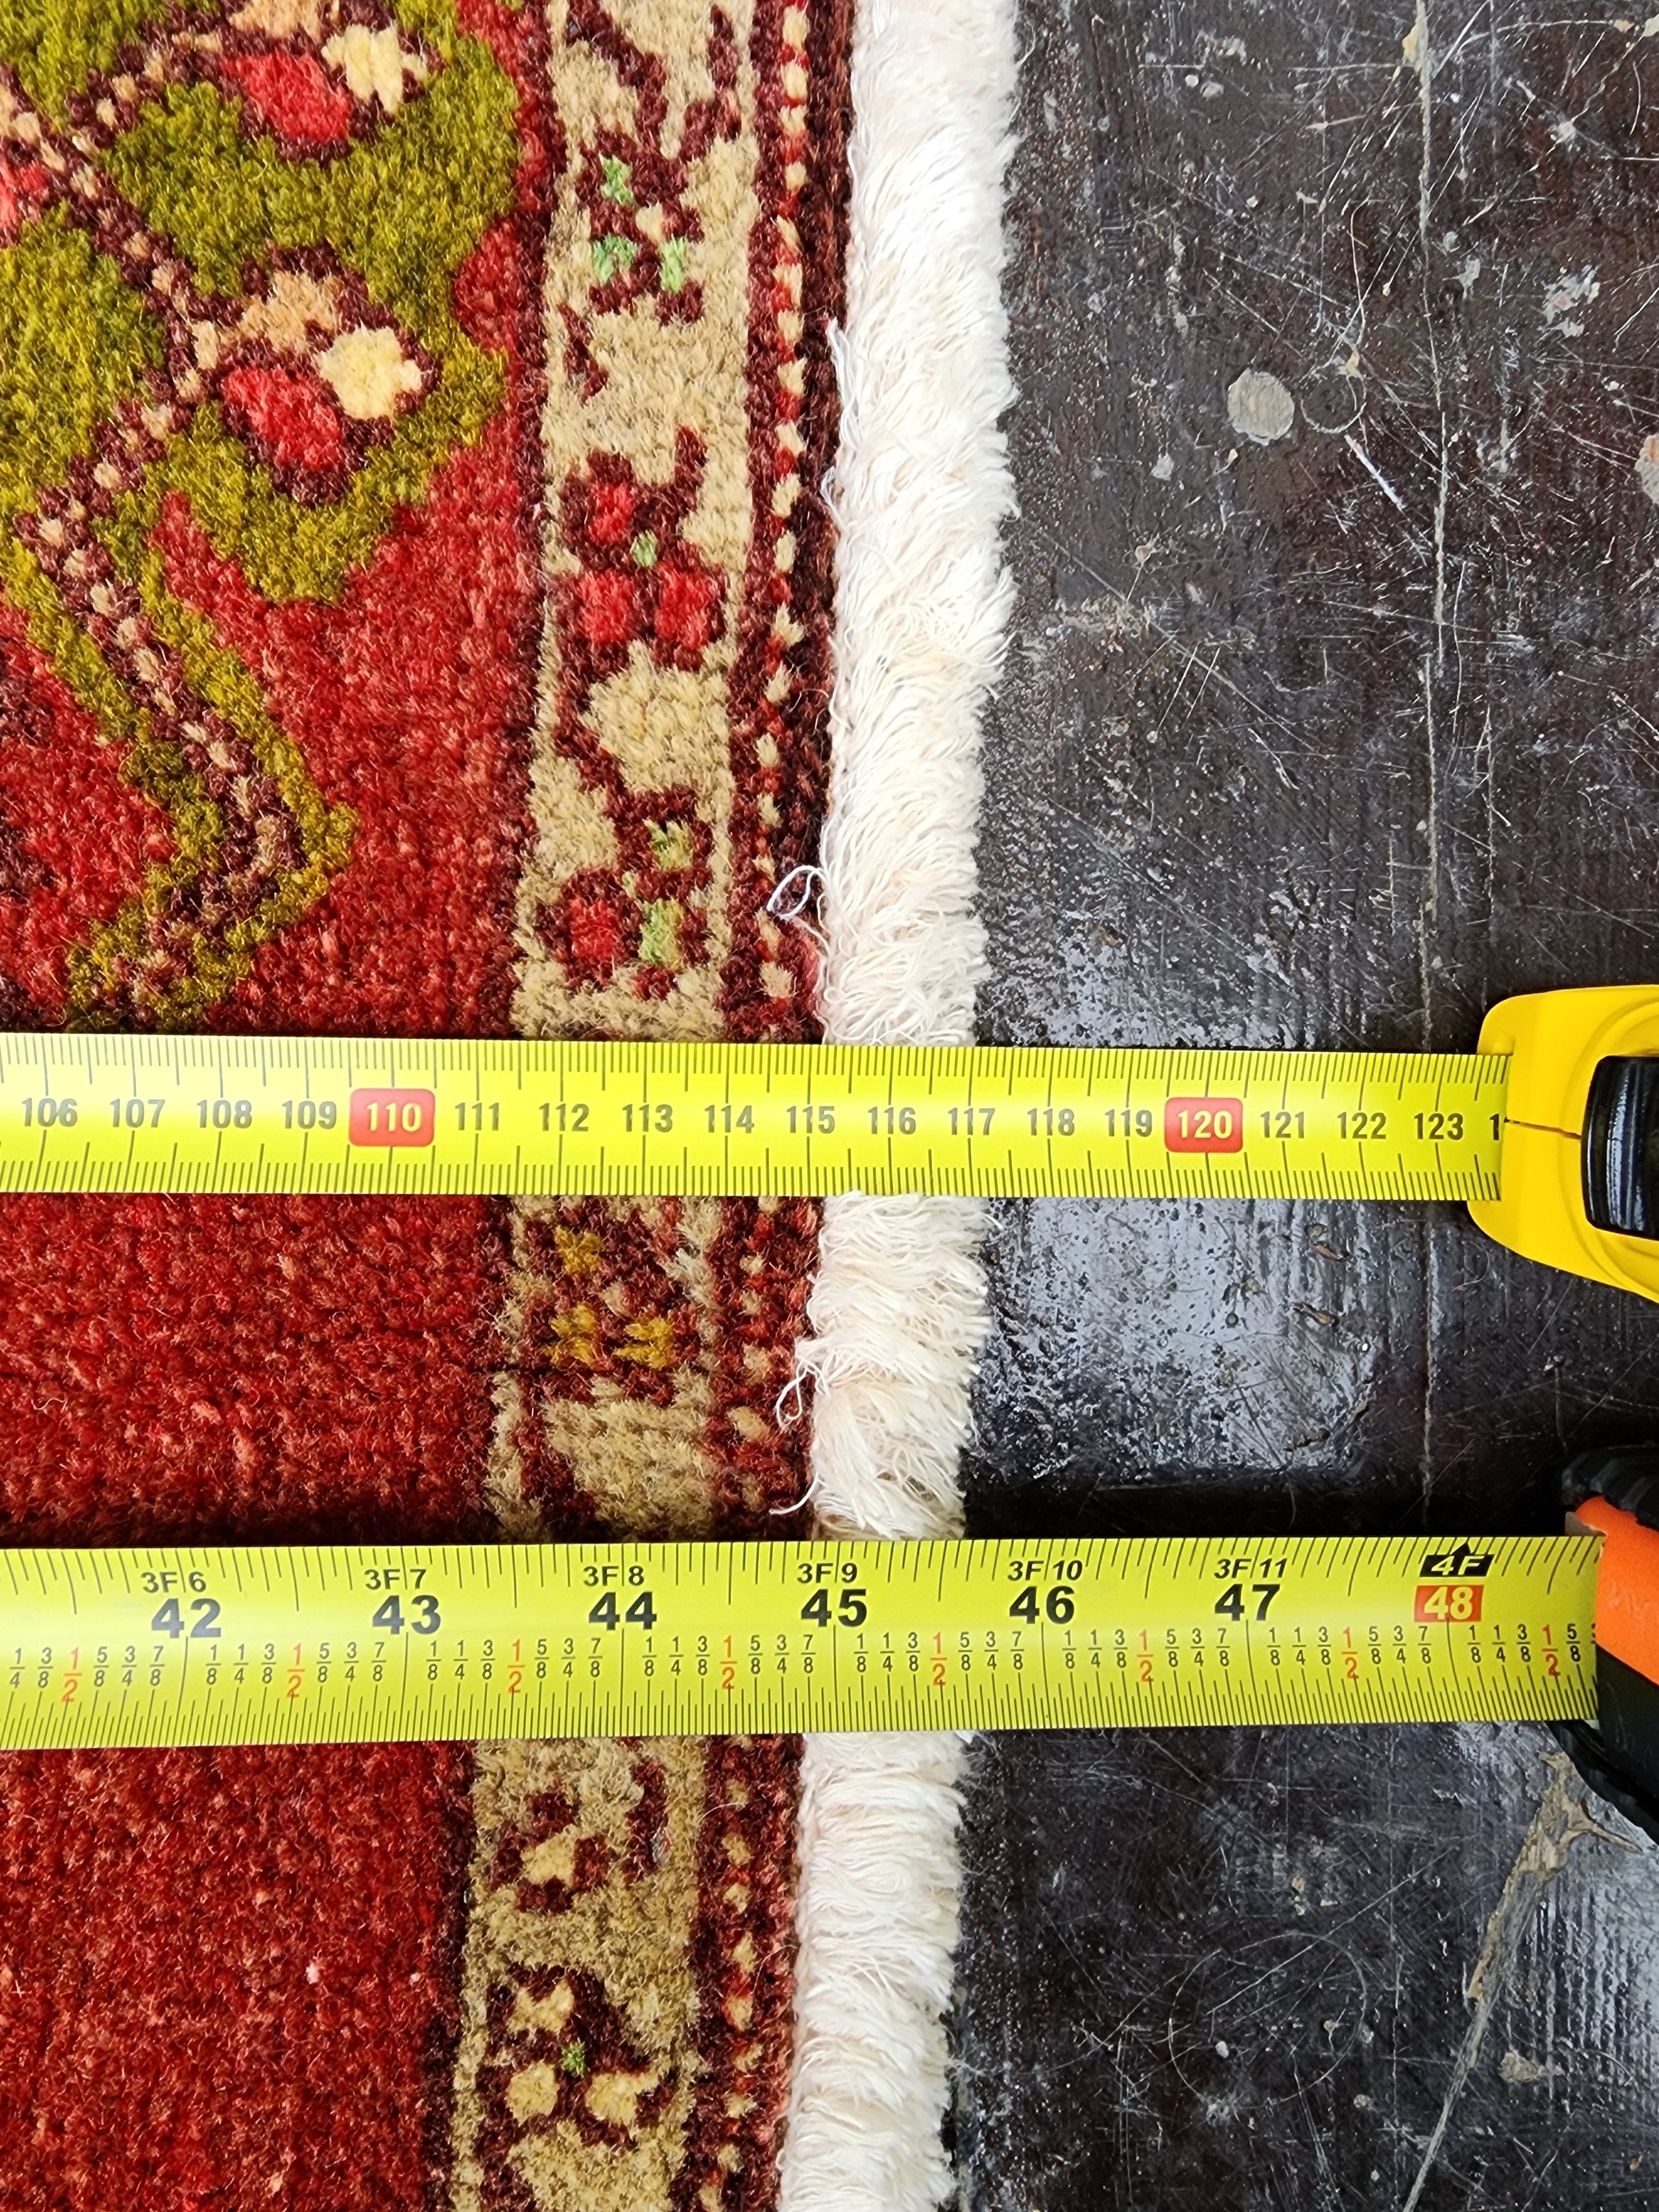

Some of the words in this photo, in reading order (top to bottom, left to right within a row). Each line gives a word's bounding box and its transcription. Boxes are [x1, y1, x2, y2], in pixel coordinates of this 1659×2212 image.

[22, 1098, 77, 1127] 106
[110, 1099, 165, 1128] 107
[197, 1099, 252, 1129] 108
[282, 1100, 337, 1129] 109
[366, 1103, 421, 1131] 110
[455, 1102, 499, 1131] 111
[539, 1103, 589, 1131] 112
[622, 1104, 672, 1133] 113
[705, 1105, 754, 1134] 114
[786, 1106, 835, 1134] 115
[868, 1107, 916, 1135] 116
[948, 1108, 995, 1135] 117
[1027, 1108, 1074, 1136] 118
[1105, 1109, 1152, 1137] 119
[1177, 1111, 1233, 1139] 120
[1260, 1112, 1304, 1139] 121
[1337, 1112, 1386, 1139] 122
[1414, 1113, 1463, 1140] 123
[1431, 1556, 1485, 1575] 4F
[152, 1598, 221, 1639] 42
[372, 1595, 441, 1635] 43
[588, 1591, 657, 1631] 44
[801, 1588, 867, 1627] 45
[1009, 1585, 1074, 1624] 46
[1214, 1584, 1280, 1621] 47
[1424, 1587, 1473, 1620] 48
